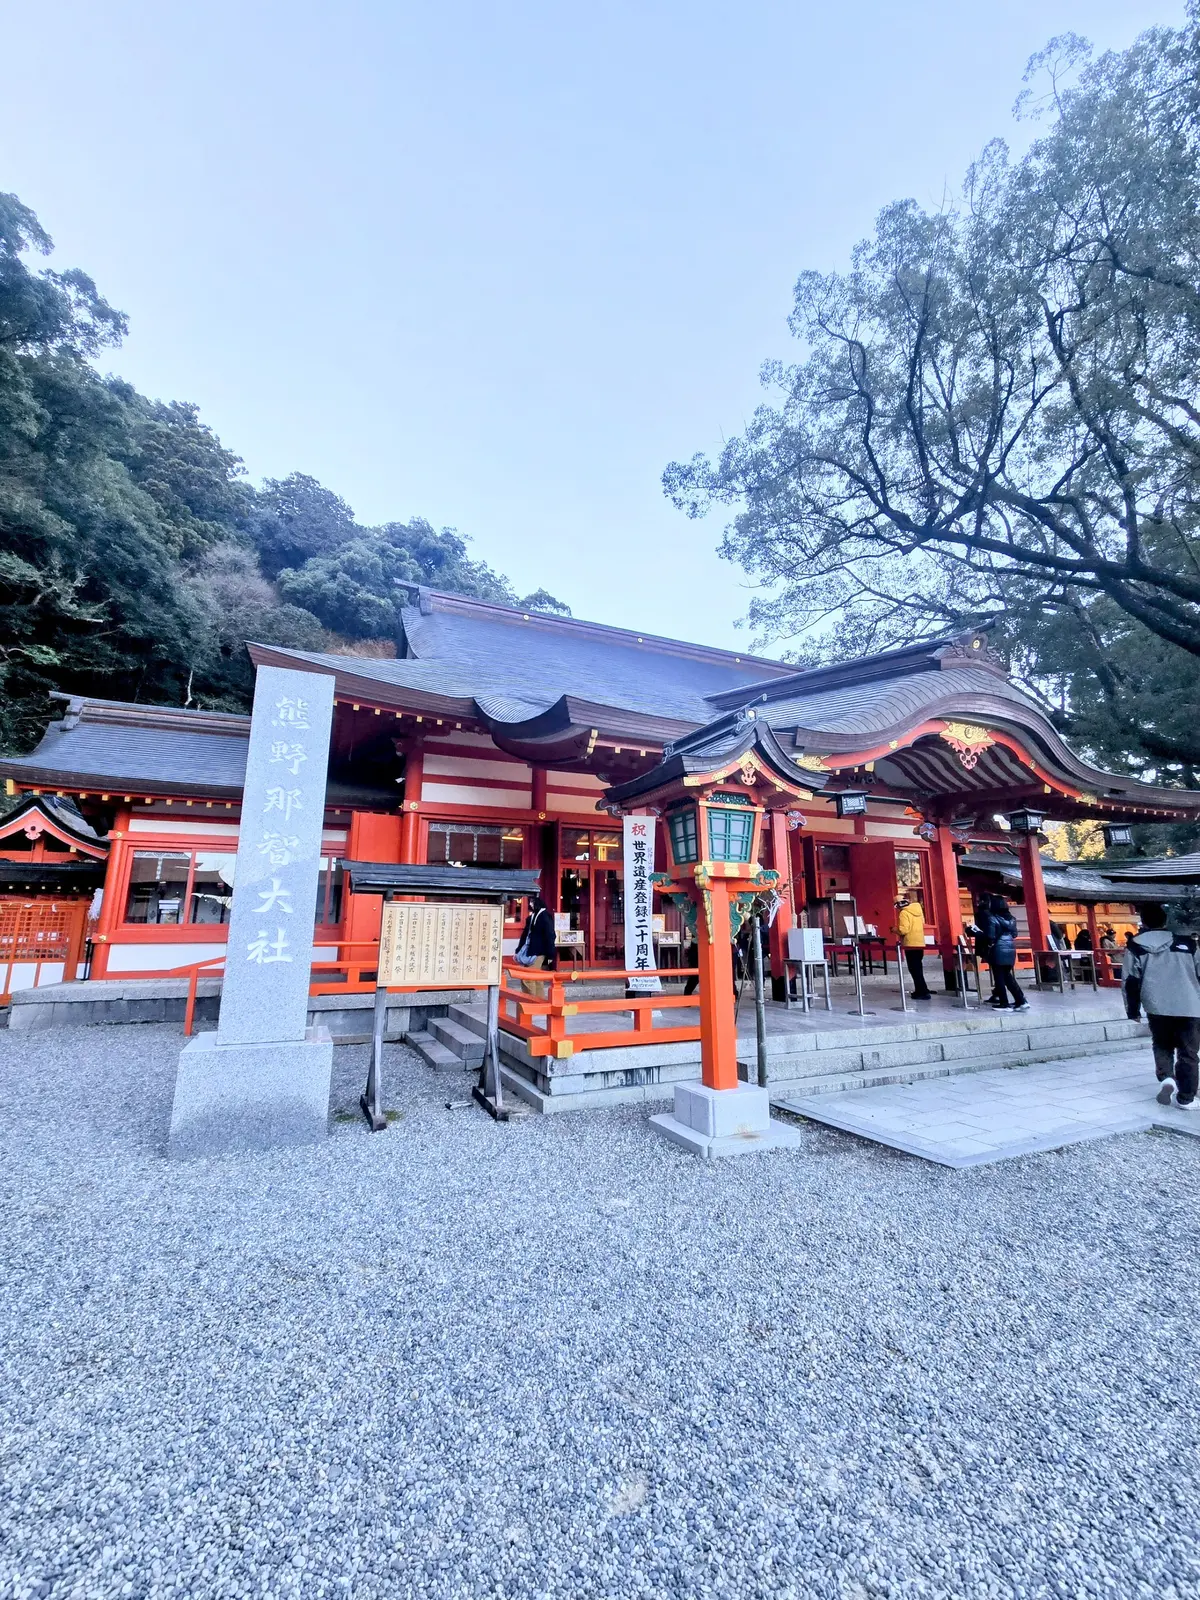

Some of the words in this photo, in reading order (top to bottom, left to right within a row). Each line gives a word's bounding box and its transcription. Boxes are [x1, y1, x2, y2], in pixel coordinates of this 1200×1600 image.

[245, 695, 312, 965] 熊野那智大社
[631, 823, 647, 837] 祝
[632, 840, 650, 971] 世界遺産登録二十周年
